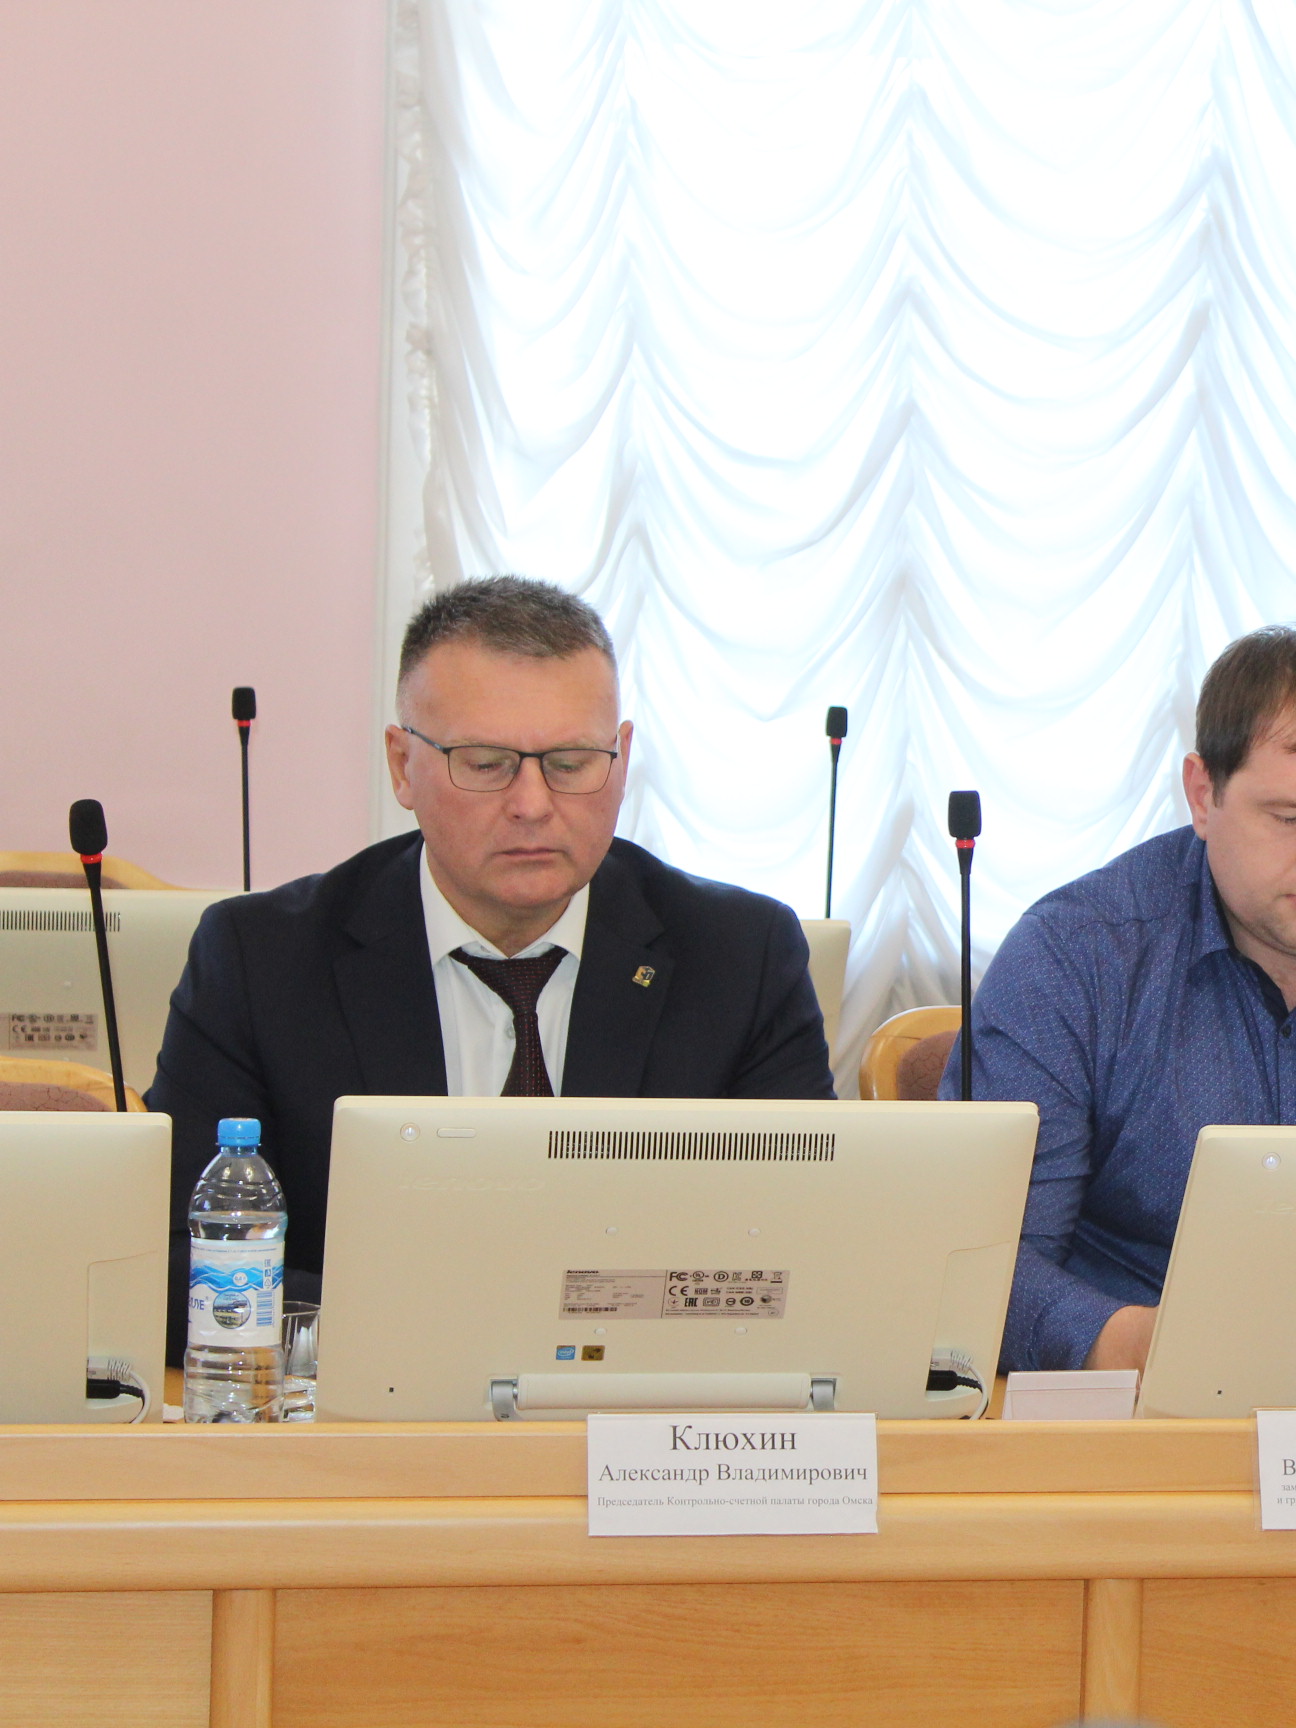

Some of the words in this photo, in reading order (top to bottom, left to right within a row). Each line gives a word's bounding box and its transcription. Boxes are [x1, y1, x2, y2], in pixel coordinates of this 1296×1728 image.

[670, 1425, 796, 1450] Клюхин
[599, 1465, 709, 1485] Александр
[718, 1464, 867, 1485] Владимирович
[598, 1497, 664, 1507] Председатель
[668, 1497, 767, 1506] Контрольно-счетной
[808, 1498, 839, 1507] города
[842, 1496, 872, 1505] Омска
